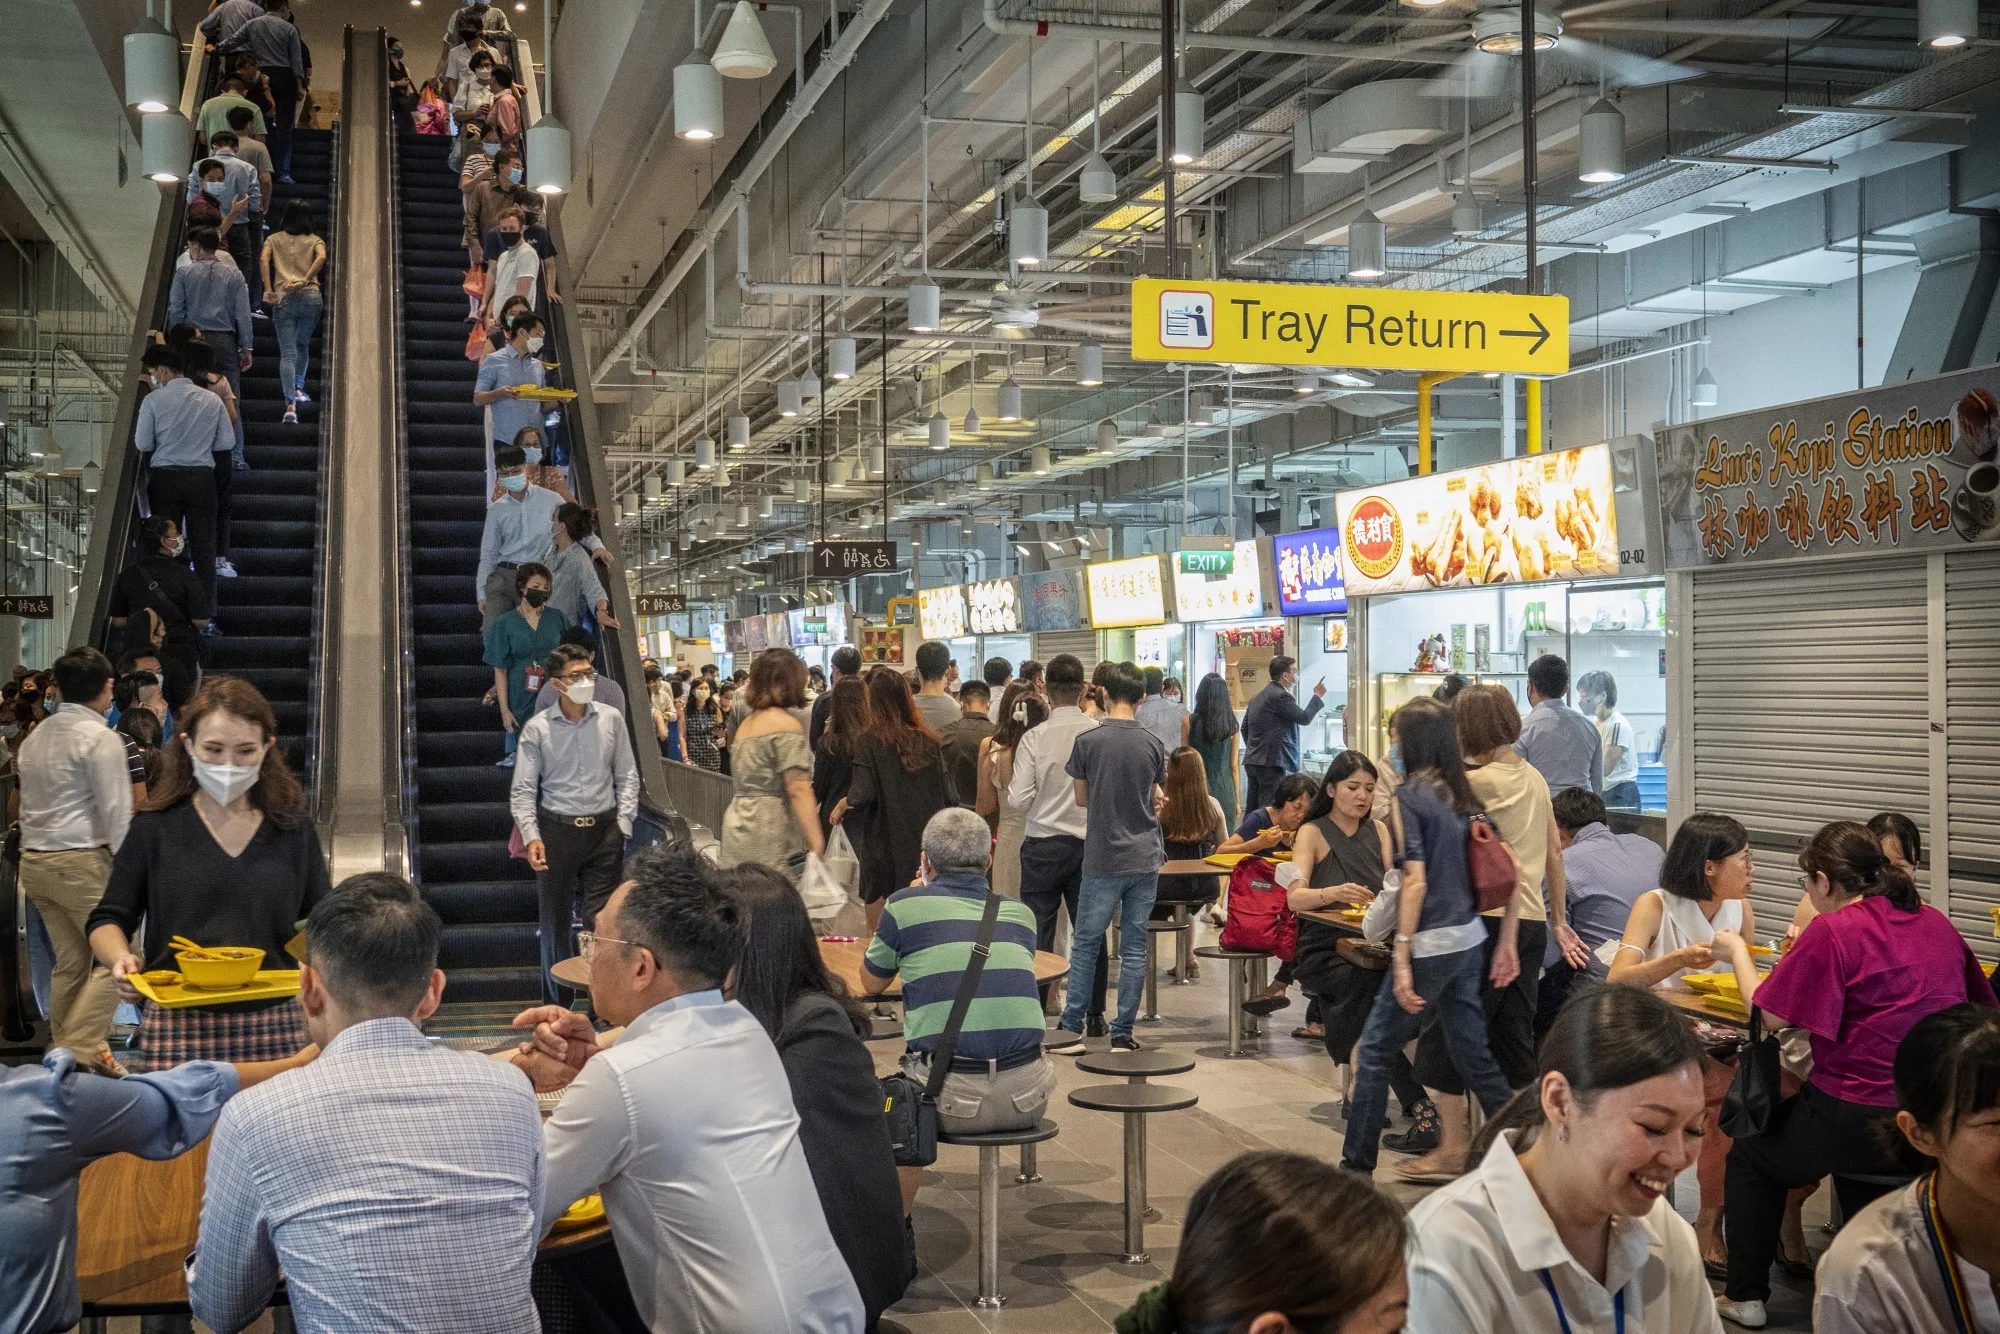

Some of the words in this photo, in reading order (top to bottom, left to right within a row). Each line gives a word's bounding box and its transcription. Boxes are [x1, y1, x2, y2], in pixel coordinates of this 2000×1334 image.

[1231, 298, 1328, 353] Tray
[1346, 304, 1487, 351] Return
[1695, 434, 1763, 492] Lim's
[1768, 419, 1836, 486] Kopi
[1842, 406, 1953, 470] Station
[1187, 554, 1219, 571] EXIT
[1620, 549, 1645, 565] 02-02
